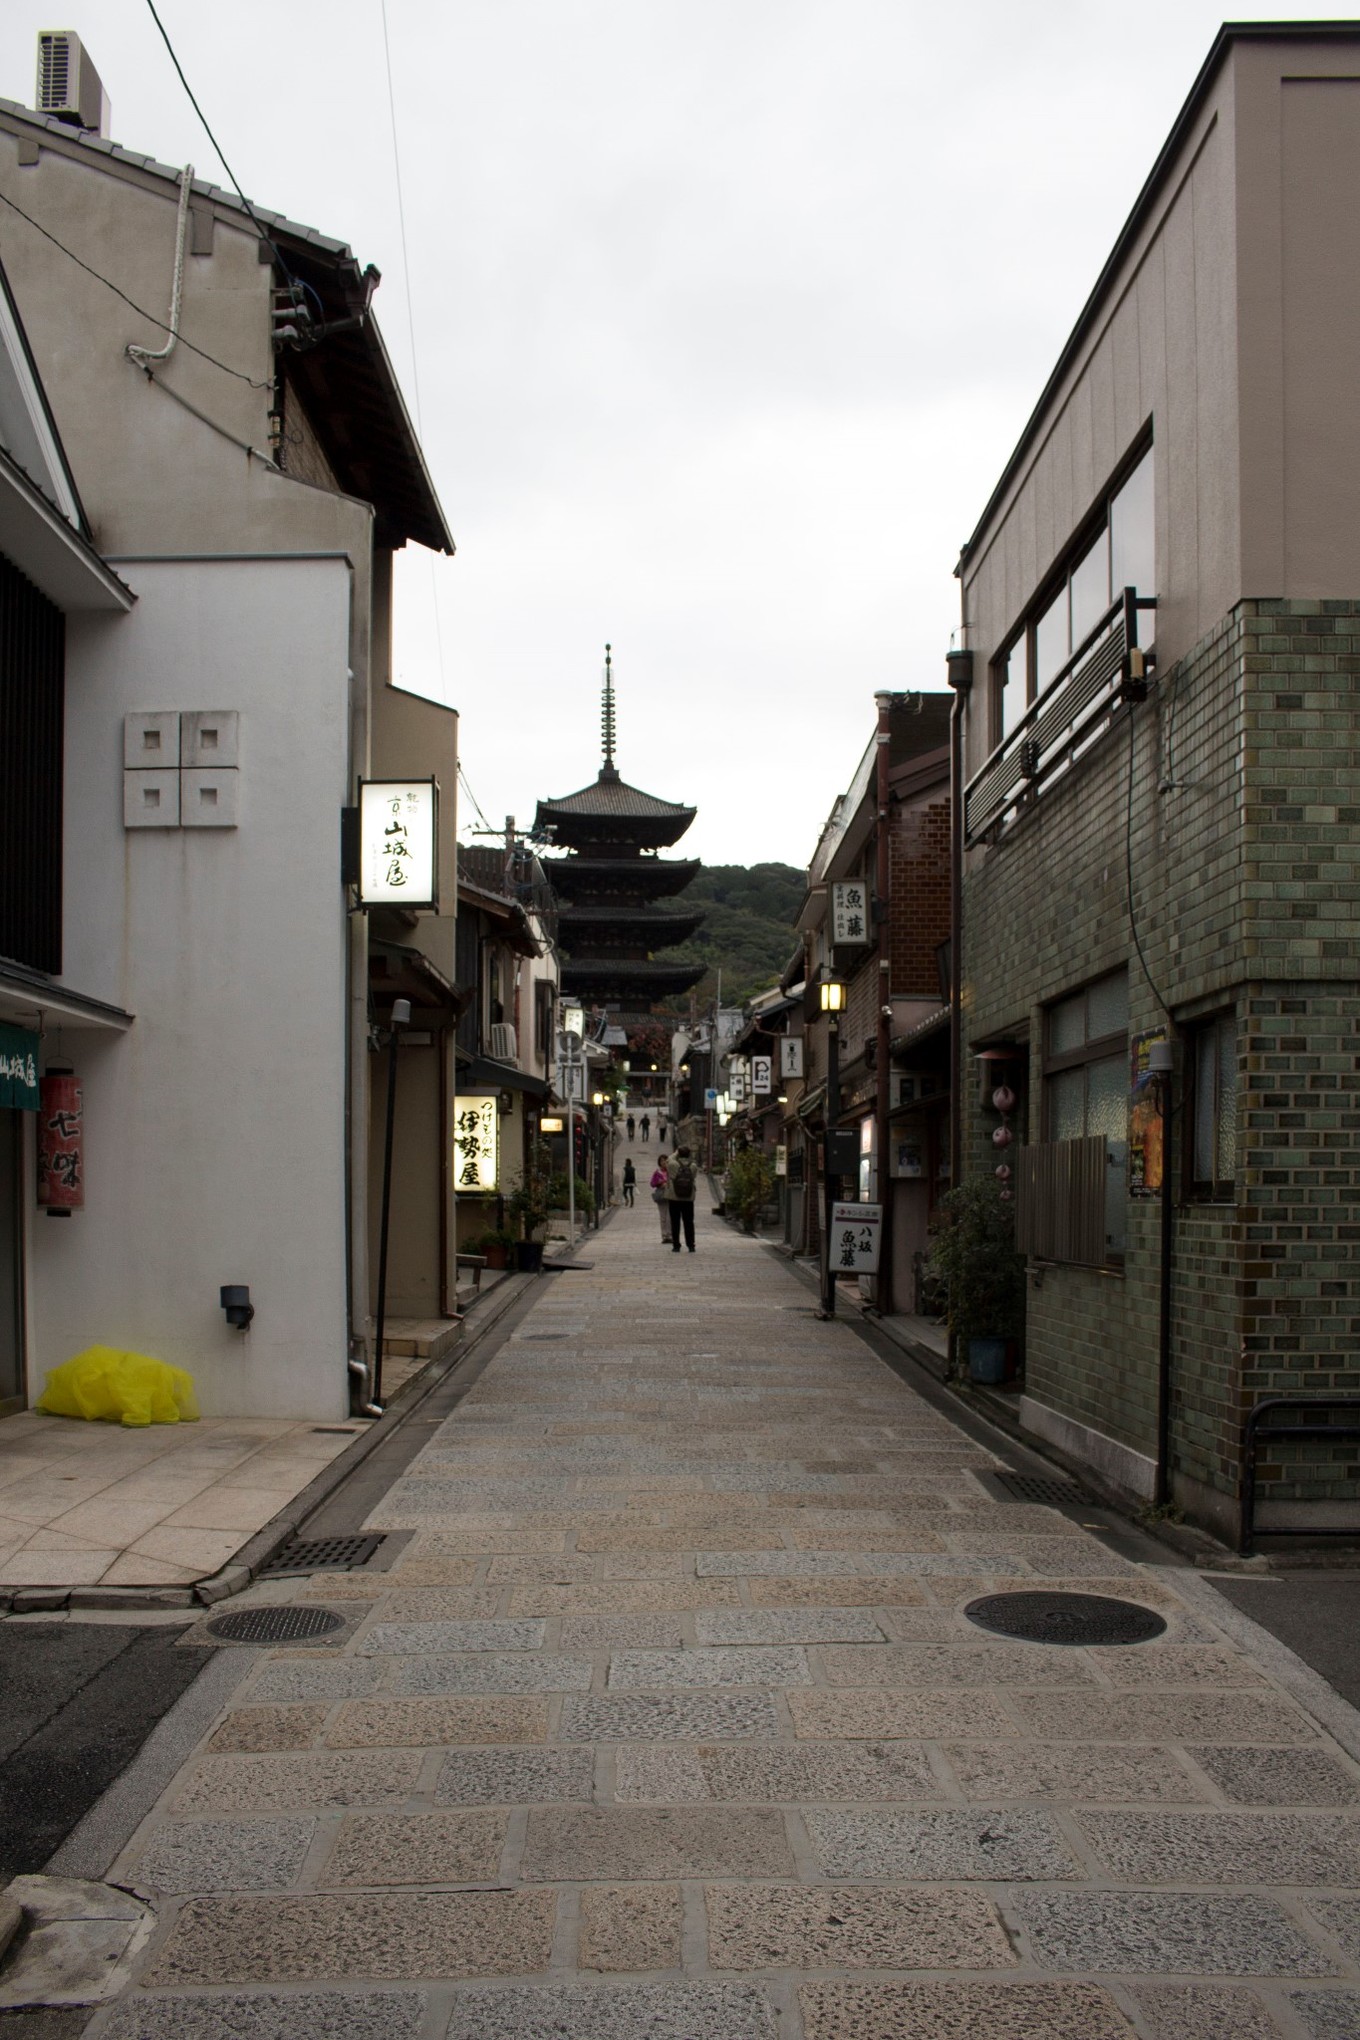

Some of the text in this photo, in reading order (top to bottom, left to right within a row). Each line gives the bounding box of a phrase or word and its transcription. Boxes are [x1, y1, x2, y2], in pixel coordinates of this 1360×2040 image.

[382, 795, 413, 886] 京山城屋
[846, 888, 863, 936] 魚藤
[48, 1111, 80, 1188] 七味
[457, 1110, 480, 1186] 伊勢屋
[840, 1230, 856, 1266] 魚藤
[858, 1226, 872, 1253] 八坂
